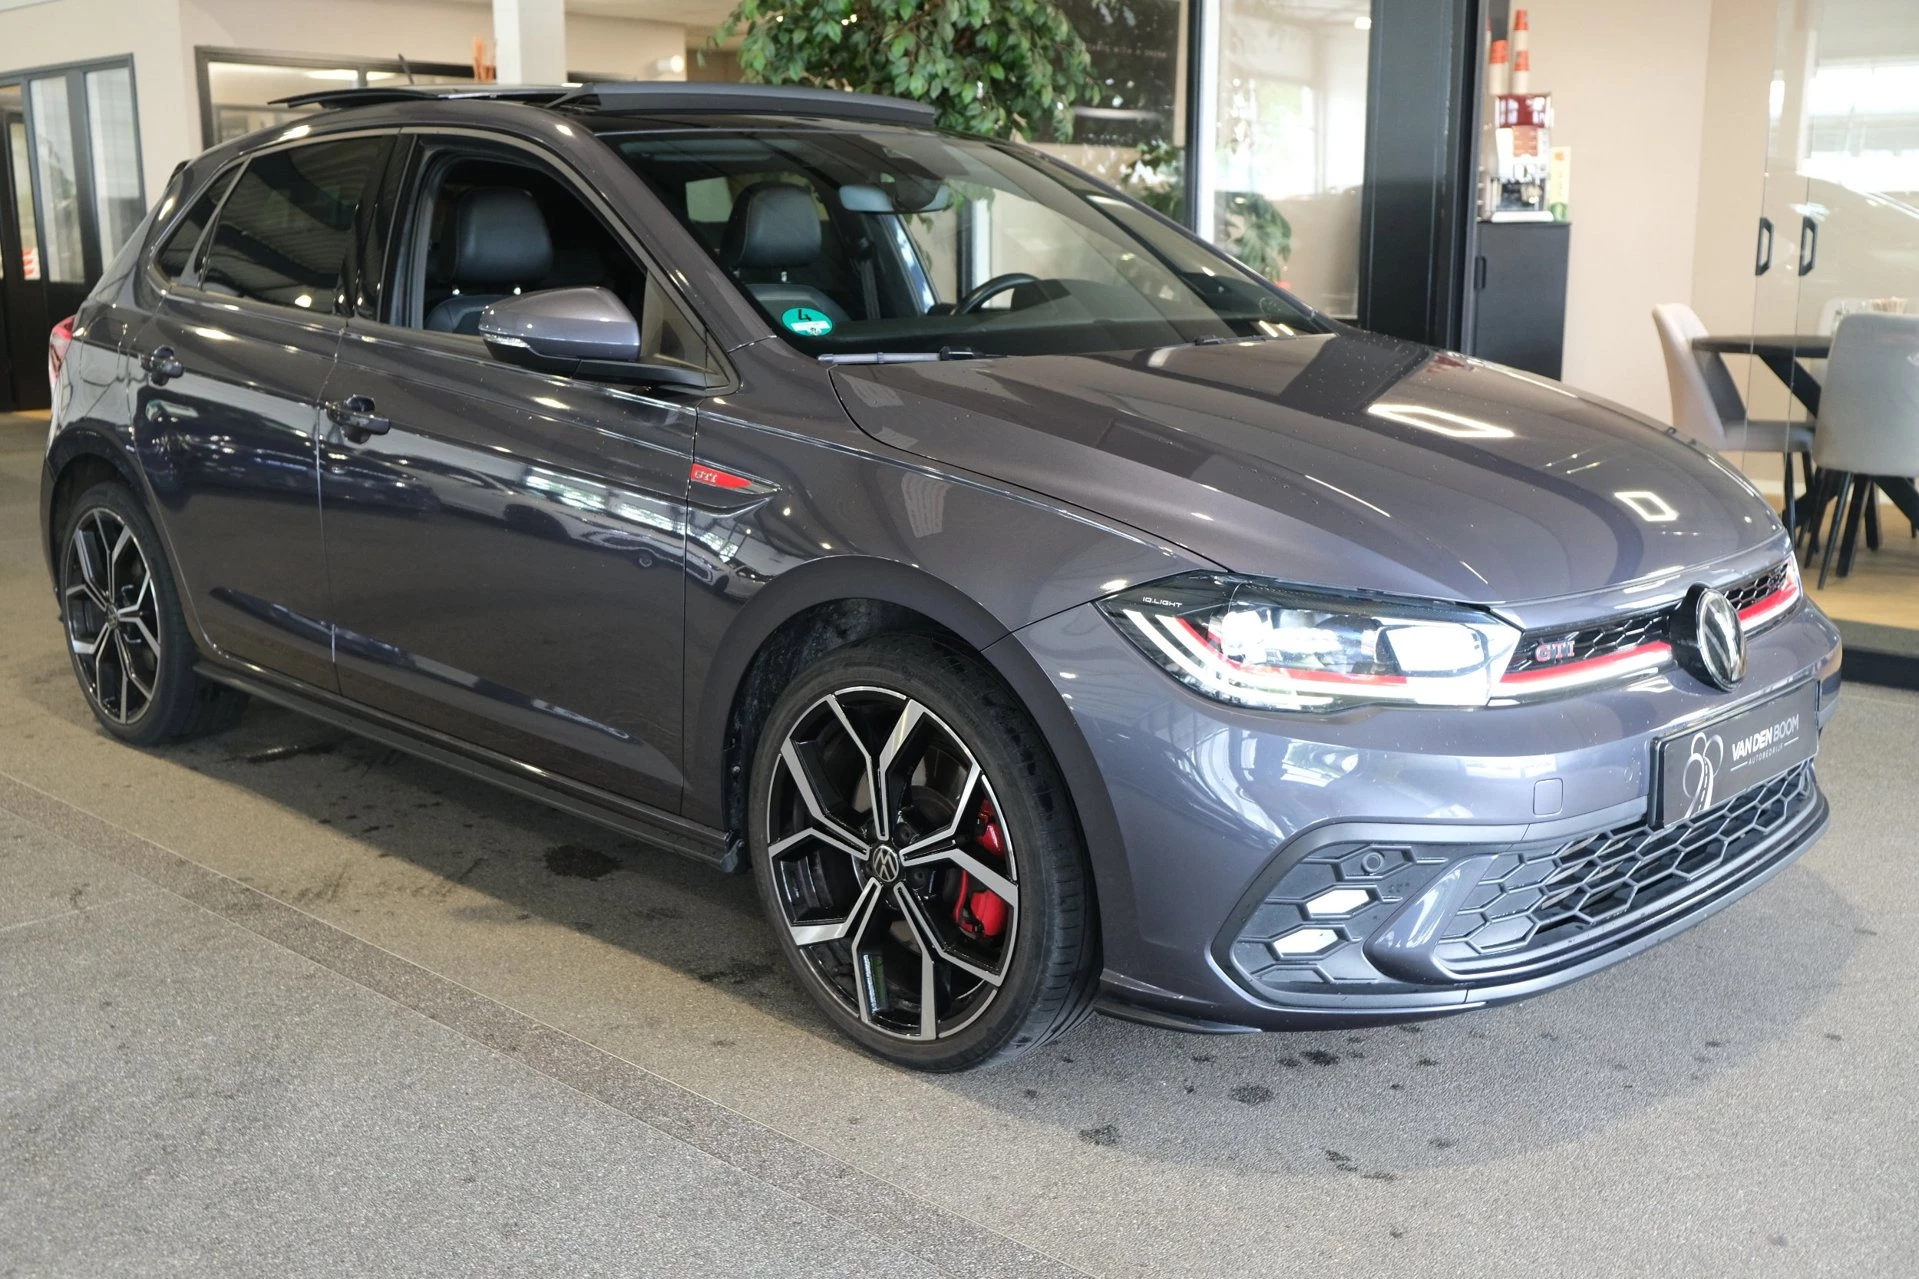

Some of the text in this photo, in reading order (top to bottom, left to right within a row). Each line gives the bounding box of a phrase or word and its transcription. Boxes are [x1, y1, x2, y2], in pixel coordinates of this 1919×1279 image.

[798, 309, 812, 322] 4
[694, 470, 719, 483] GTI
[1142, 596, 1183, 608] IQ.LIGHT
[1534, 640, 1576, 663] GTI
[1773, 713, 1799, 743] BOOM
